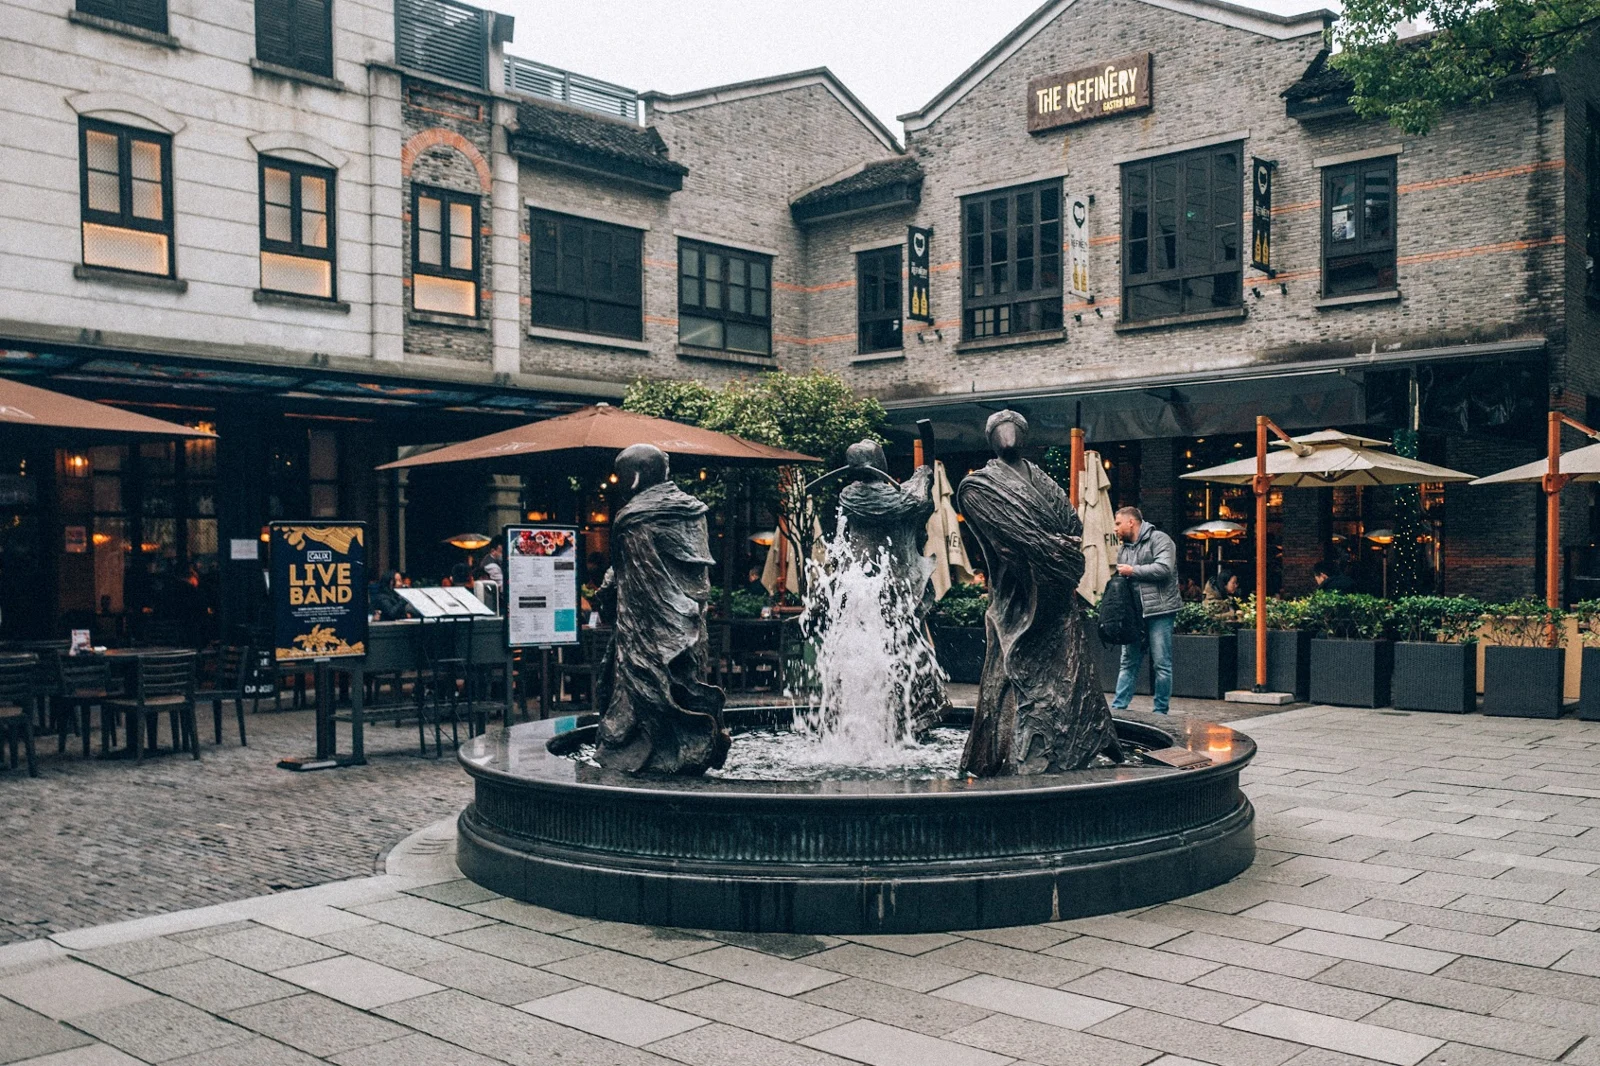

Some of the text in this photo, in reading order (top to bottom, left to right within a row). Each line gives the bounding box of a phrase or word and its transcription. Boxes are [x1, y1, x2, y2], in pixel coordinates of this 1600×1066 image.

[1036, 65, 1138, 114] THE REFINERY
[289, 563, 351, 586] LIVE
[290, 585, 352, 605] BAND
